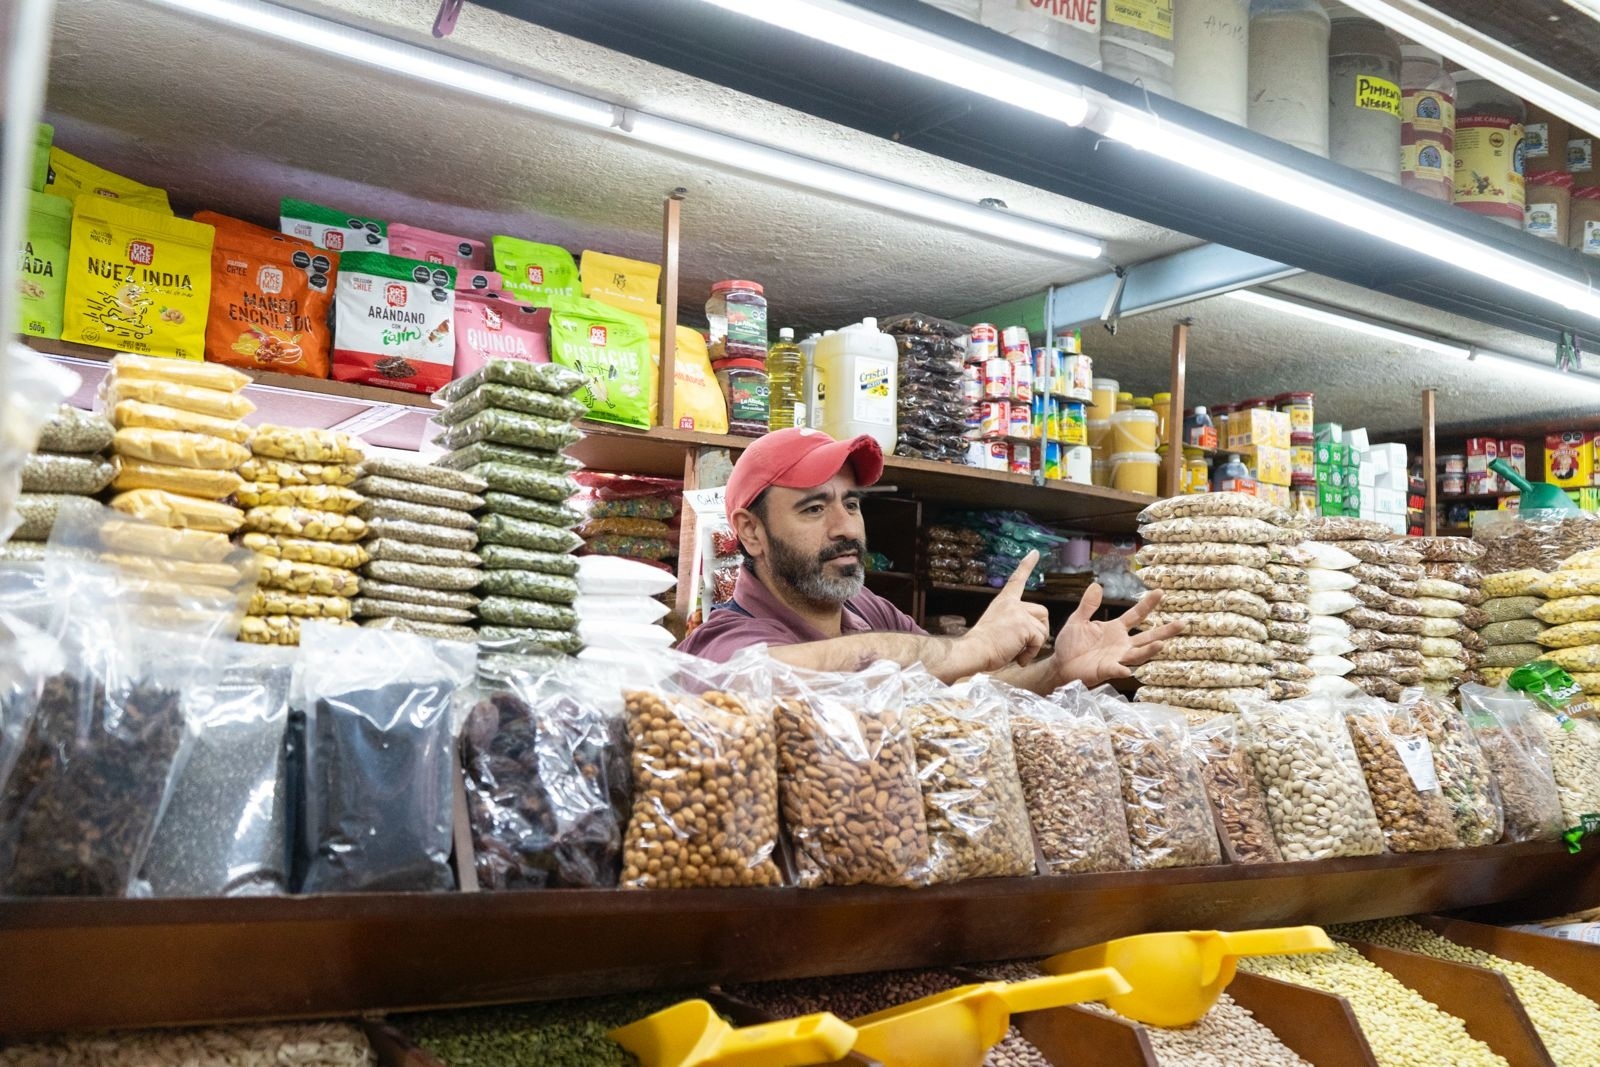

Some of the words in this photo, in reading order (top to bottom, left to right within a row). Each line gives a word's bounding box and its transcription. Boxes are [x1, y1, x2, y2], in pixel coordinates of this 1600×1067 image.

[326, 231, 343, 242] PRE
[132, 243, 152, 257] PRE
[87, 256, 136, 284] NUEZ
[142, 268, 193, 291] INDIA
[352, 282, 373, 293] CHILE
[228, 302, 313, 333] ENCHILADO
[466, 327, 529, 355] QUINOA
[563, 343, 639, 369] PISTACHE
[859, 366, 889, 383] Cristal
